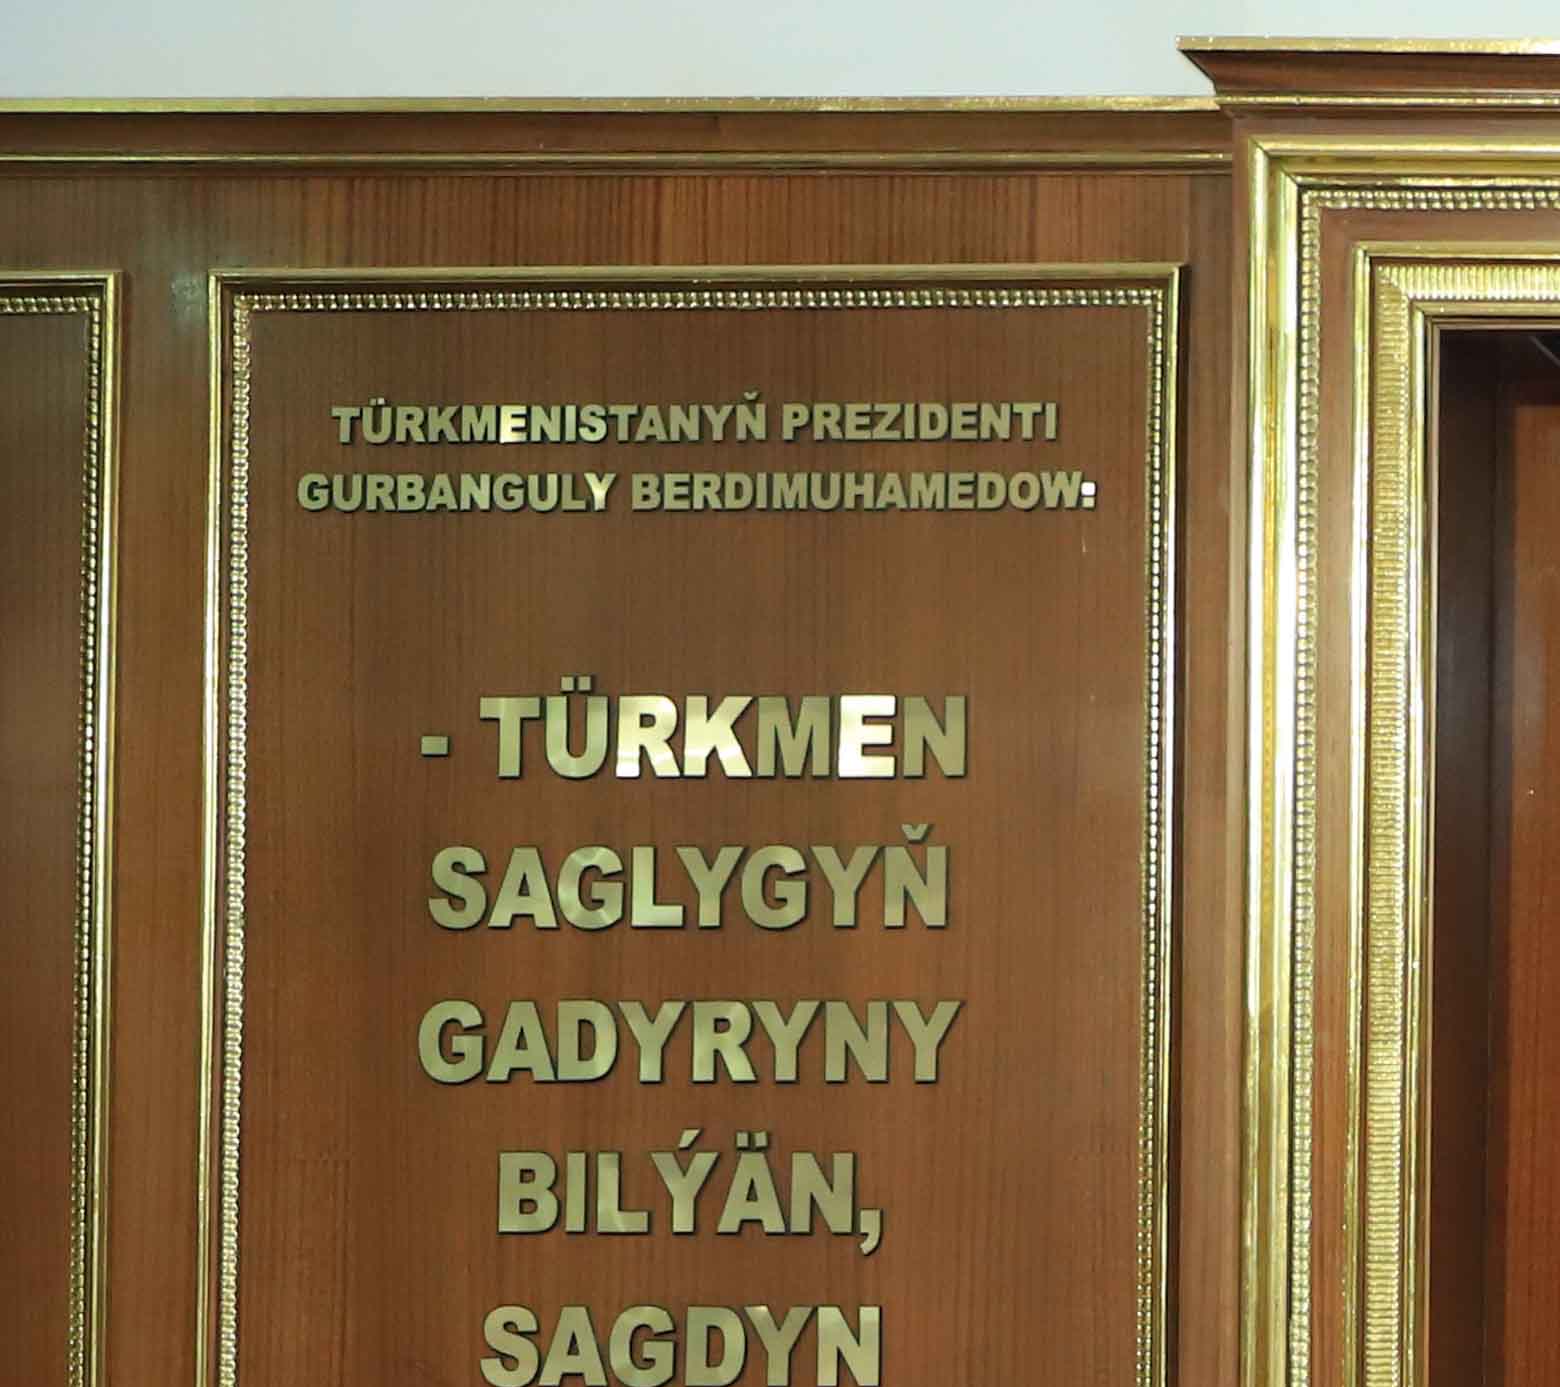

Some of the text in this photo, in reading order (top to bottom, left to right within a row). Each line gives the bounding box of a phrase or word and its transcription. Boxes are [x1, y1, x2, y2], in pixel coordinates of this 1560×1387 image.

[330, 391, 1058, 445] TÜRKMENISTANYŇ PREZIDENTI
[296, 469, 1097, 512] GURBANGULY BERDIMUHAMEDOW:
[420, 675, 966, 779] - TÜRKMEN
[427, 821, 948, 930] SAGLYGYŇ
[417, 999, 961, 1084] GADYRYNY
[497, 1128, 882, 1255] BILÝÄN,
